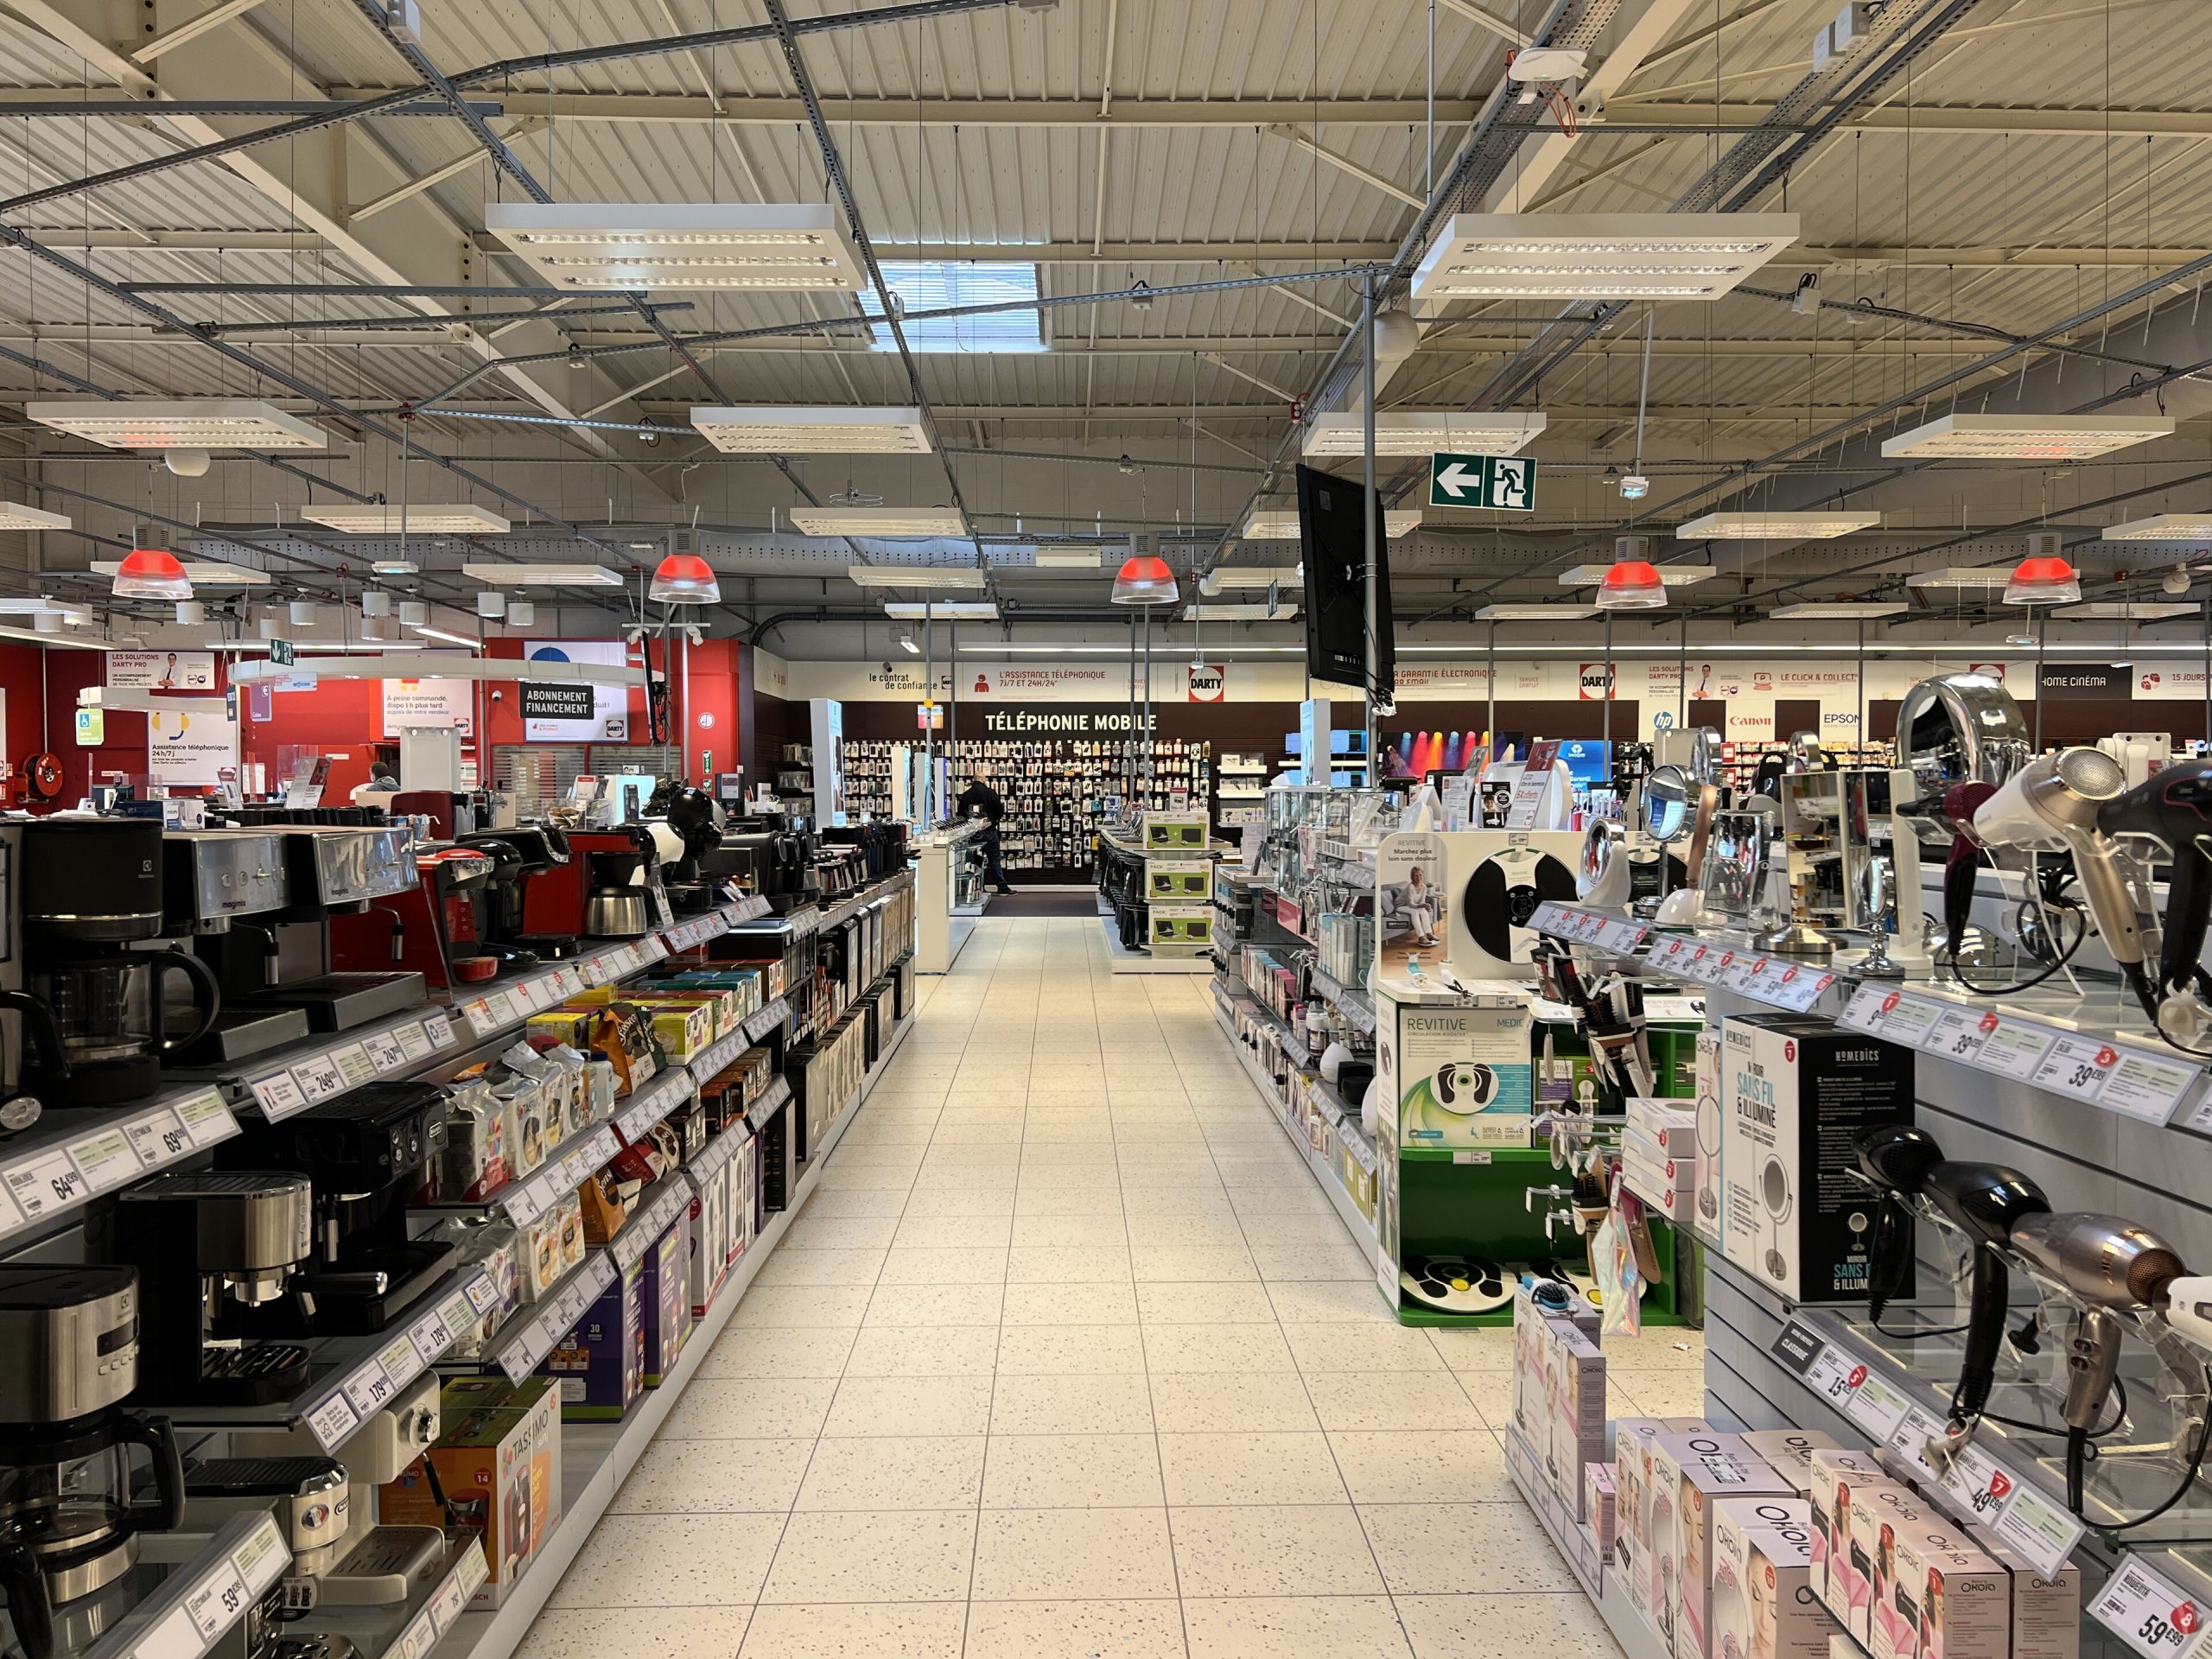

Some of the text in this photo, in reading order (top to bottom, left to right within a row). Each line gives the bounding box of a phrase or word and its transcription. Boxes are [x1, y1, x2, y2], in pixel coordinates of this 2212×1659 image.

[869, 673, 909, 682] le contrat
[1000, 669, 1106, 680] L'ASSISTANCE TÉLÉPHONIQUE
[1440, 668, 1497, 679] ÉLECTRONIQE
[885, 681, 938, 690] de confiane
[999, 679, 1015, 688] 7J/7
[1190, 677, 1222, 690] DARTY
[2041, 675, 2107, 687] HOME CINÉMA
[412, 694, 448, 702] commandé,
[526, 690, 587, 702] ABONNEMENT
[387, 702, 404, 710] dispo
[416, 702, 429, 710] plus
[525, 702, 588, 715] FINANCEMENT
[985, 711, 1157, 731] TÉLÉPHONIE MOBILE
[1655, 712, 1672, 728] hp
[1730, 715, 1771, 726] Canon
[1824, 714, 1859, 724] EPSON
[221, 899, 246, 910] magimix
[1408, 1018, 1466, 1031] REVITIVE
[1497, 1017, 1523, 1027] MEDIC
[1835, 1047, 1879, 1062] HOMEDICS
[2101, 1053, 2110, 1064] 3
[2069, 1065, 2107, 1087] 39€99
[1738, 1071, 1776, 1109] SANS FIL
[1744, 1098, 1777, 1129] ILLUMINÉ
[1834, 1263, 1863, 1278] SANS
[1834, 1279, 1868, 1290] & ILLUM
[590, 1324, 600, 1333] 30
[1782, 1338, 1808, 1362] CLASSIQUE
[512, 1409, 549, 1461] TASSIMO
[476, 1473, 488, 1484] 14
[1993, 1481, 2005, 1492] 7
[1972, 1488, 2004, 1513] 49€99
[2122, 1573, 2151, 1599] ROWENTA
[2181, 1613, 2193, 1626] 8
[2138, 1614, 2185, 1647] 59€99
